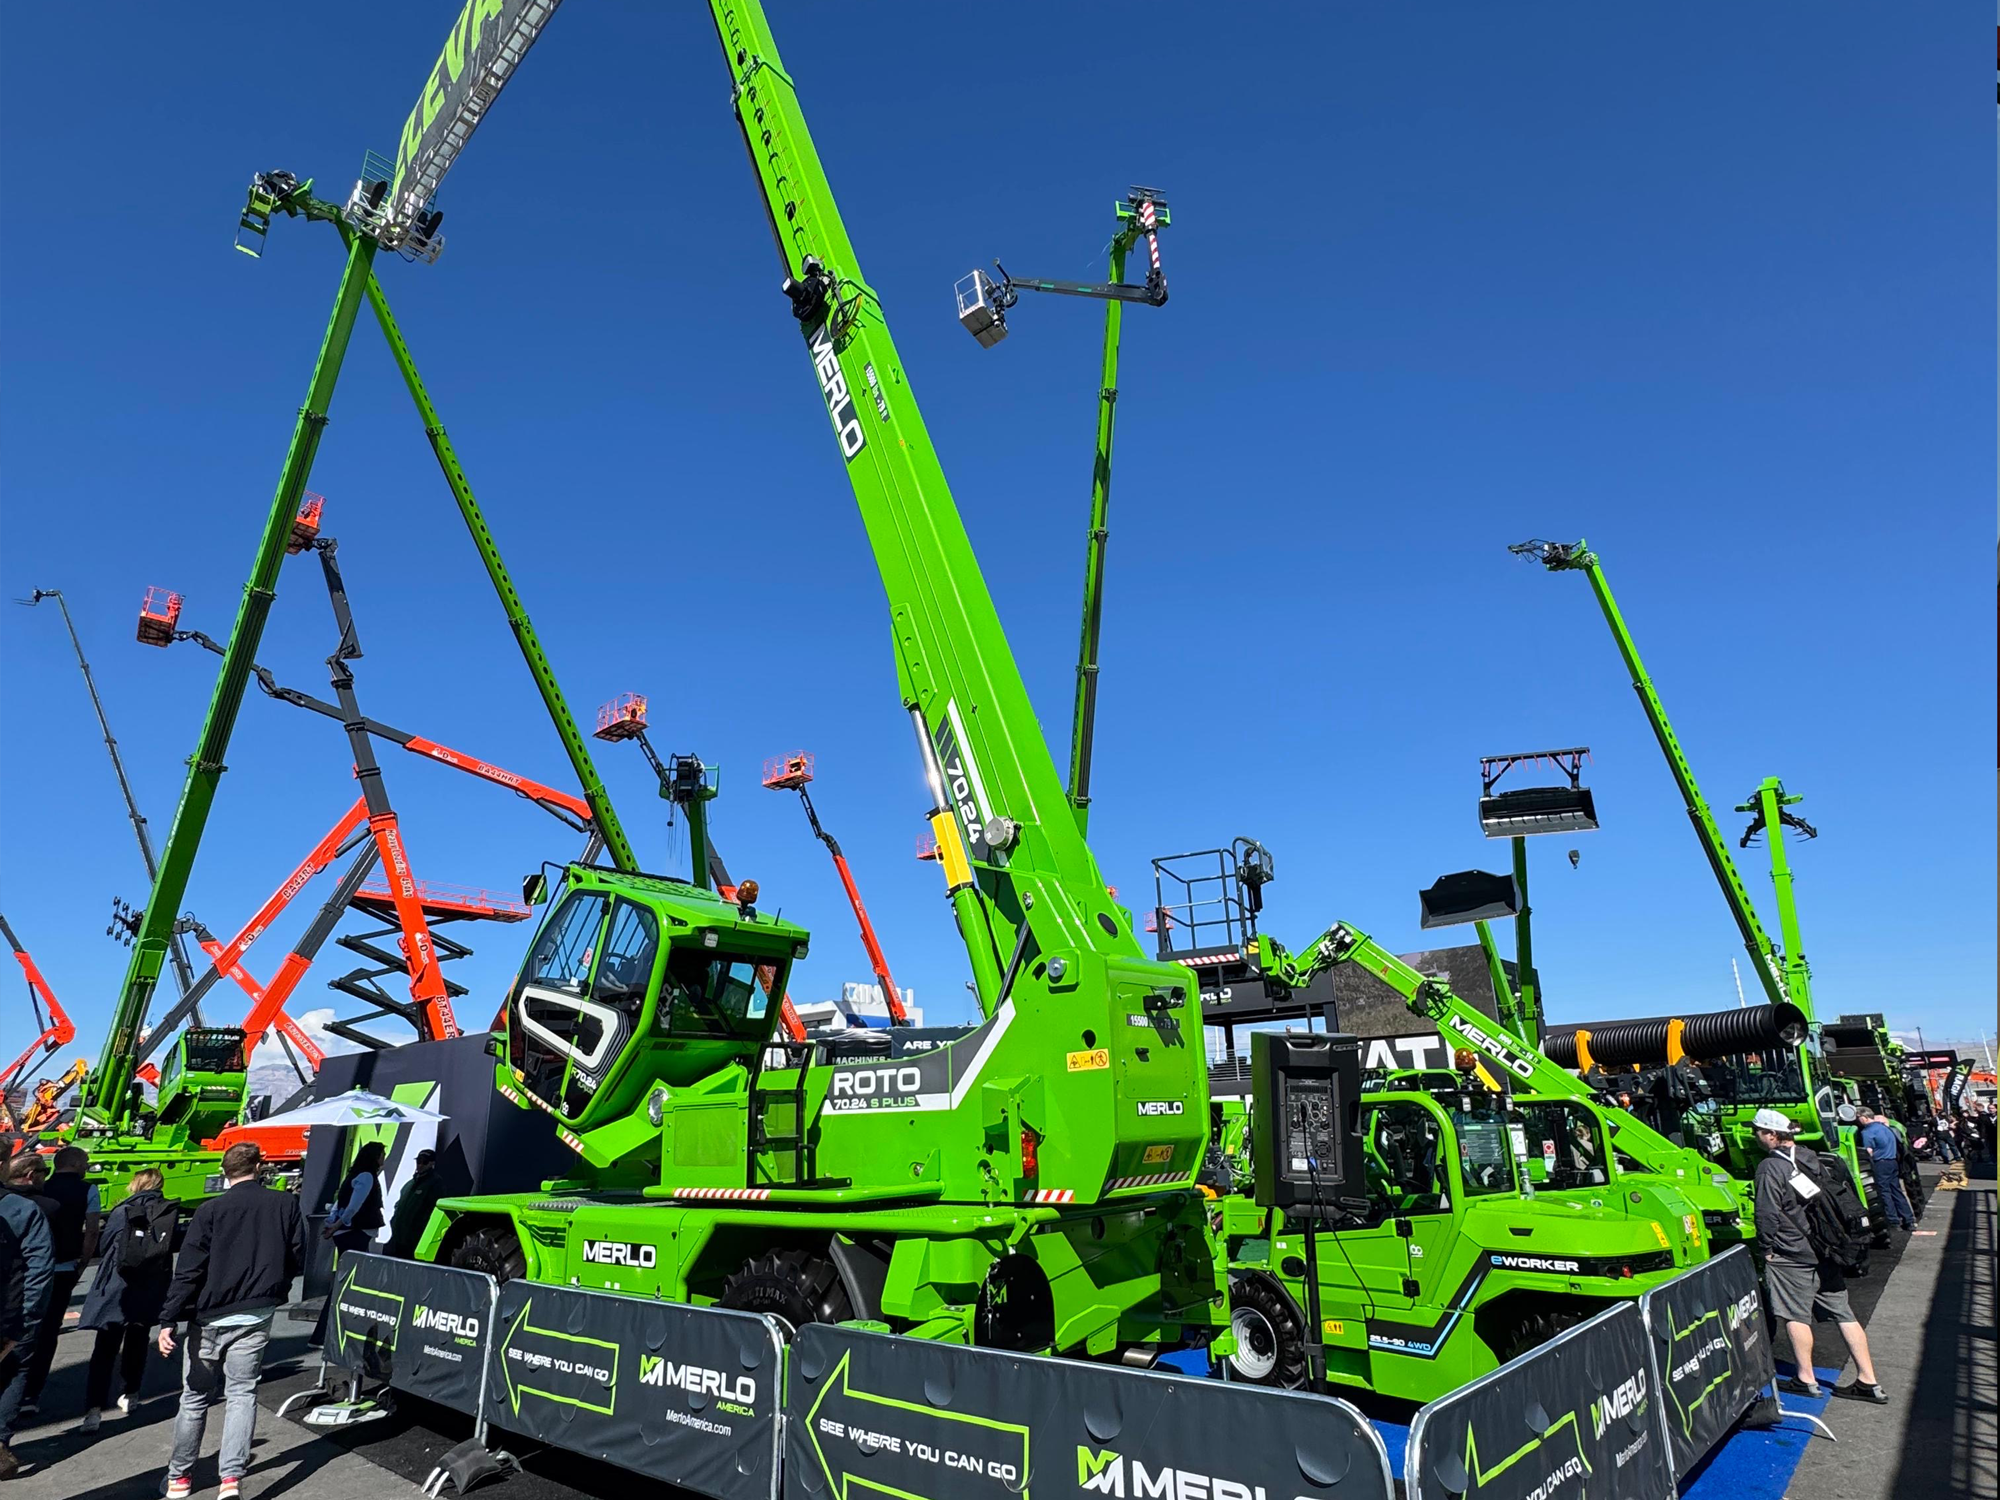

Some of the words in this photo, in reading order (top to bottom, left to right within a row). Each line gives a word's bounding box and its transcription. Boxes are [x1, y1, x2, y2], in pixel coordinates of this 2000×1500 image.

[808, 322, 864, 457] MERLO
[477, 763, 521, 785] BA44HRT
[947, 757, 983, 844] 70.24
[283, 862, 316, 898] BA44RT
[1200, 987, 1232, 1001] RLO
[903, 1041, 932, 1050] ARE
[1449, 1014, 1534, 1078] MERLO
[834, 1067, 921, 1096] ROTO
[834, 1098, 867, 1109] 70.24
[870, 1098, 879, 1108] S
[882, 1097, 916, 1107] PLUS
[1137, 1101, 1184, 1116] MERLO
[582, 1240, 657, 1268] MERLO
[1490, 1255, 1580, 1272] eWORKER
[366, 1309, 377, 1319] YO
[427, 1309, 479, 1337] MERLO
[1407, 1341, 1431, 1351] 4WD
[508, 1347, 523, 1361] SEE
[523, 1352, 552, 1368] WHERE
[553, 1359, 573, 1373] YOU
[575, 1363, 594, 1378] CAN
[594, 1368, 609, 1382] GO
[667, 1362, 756, 1405] MERLO
[1602, 1367, 1647, 1425] MERLO
[666, 1408, 732, 1437] MerloAmerica.com
[716, 1401, 756, 1418] AMERICA
[819, 1418, 844, 1437] SEE
[848, 1426, 901, 1453] WHERE
[905, 1440, 939, 1463] YOU
[944, 1451, 983, 1474] CAN
[987, 1461, 1017, 1480] GO
[1131, 1459, 1320, 1500] MER
[1546, 1466, 1566, 1494] CAN
[1564, 1456, 1582, 1478] GO
